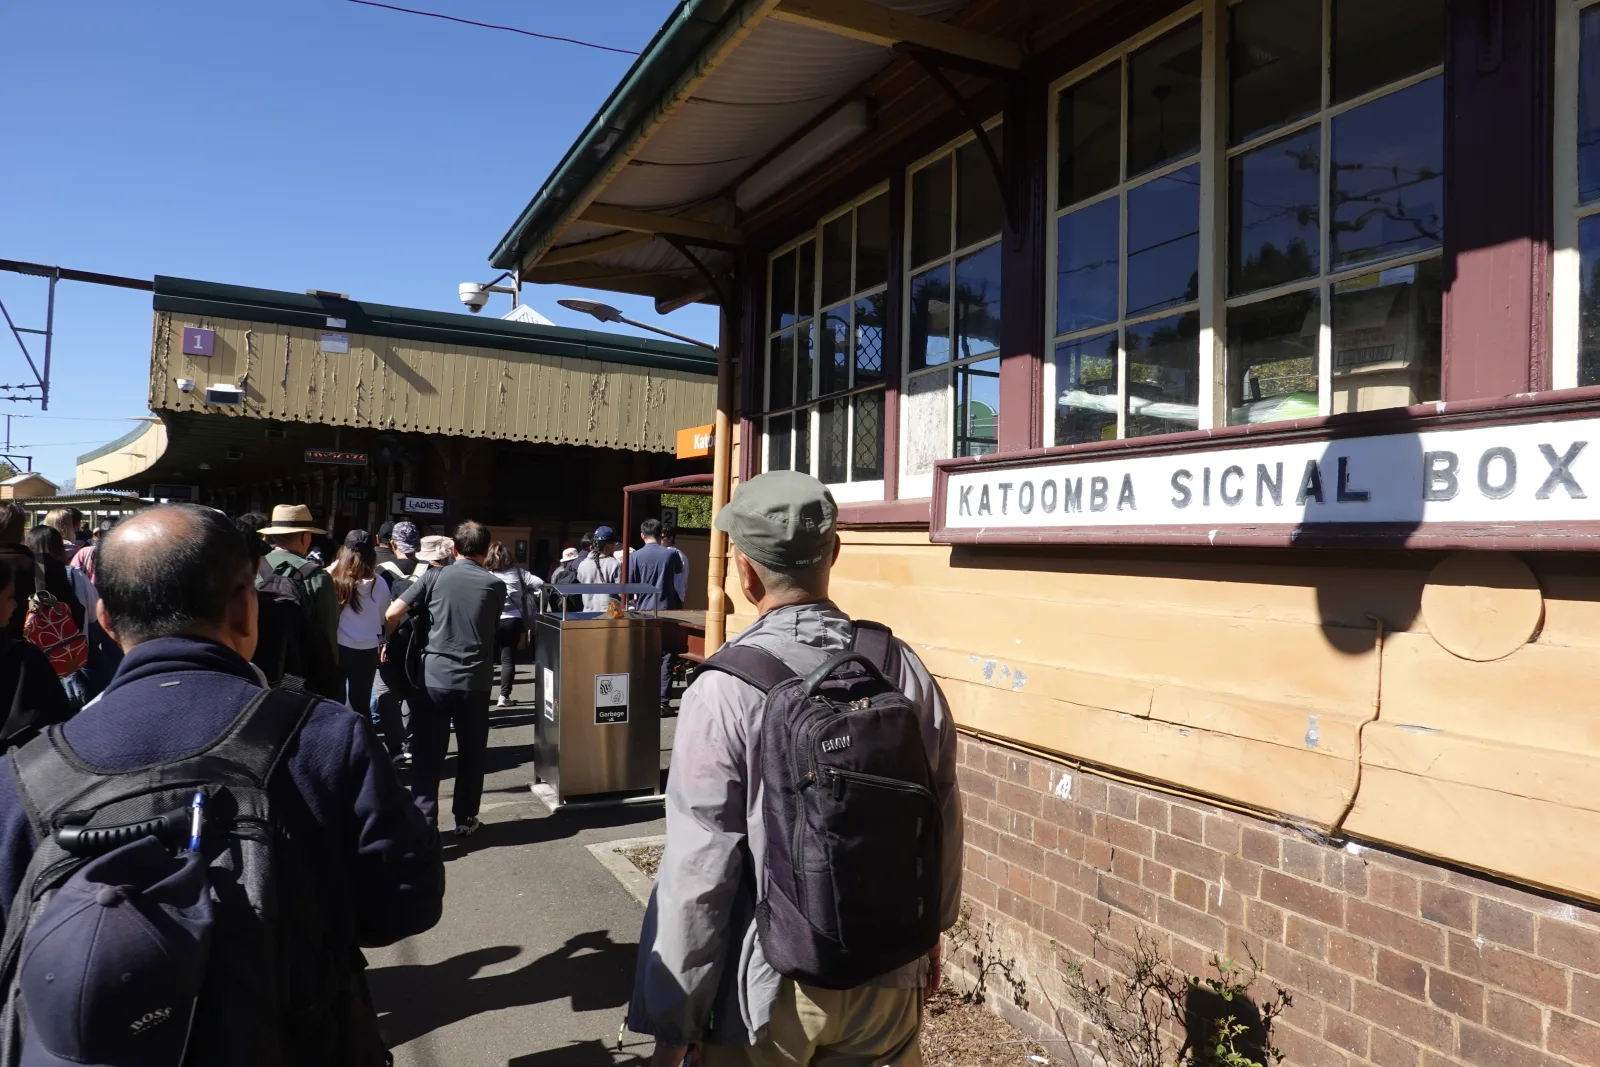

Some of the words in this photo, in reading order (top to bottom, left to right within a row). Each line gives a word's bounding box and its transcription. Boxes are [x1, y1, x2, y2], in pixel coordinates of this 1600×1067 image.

[193, 334, 203, 349] 1
[958, 472, 1138, 517] KATOOMBA
[1422, 440, 1589, 502] BOX
[409, 500, 440, 510] LADIES
[664, 511, 673, 524] 2
[599, 711, 625, 719] Garbage
[821, 735, 850, 753] BMW
[130, 1007, 172, 1030] BOSS
